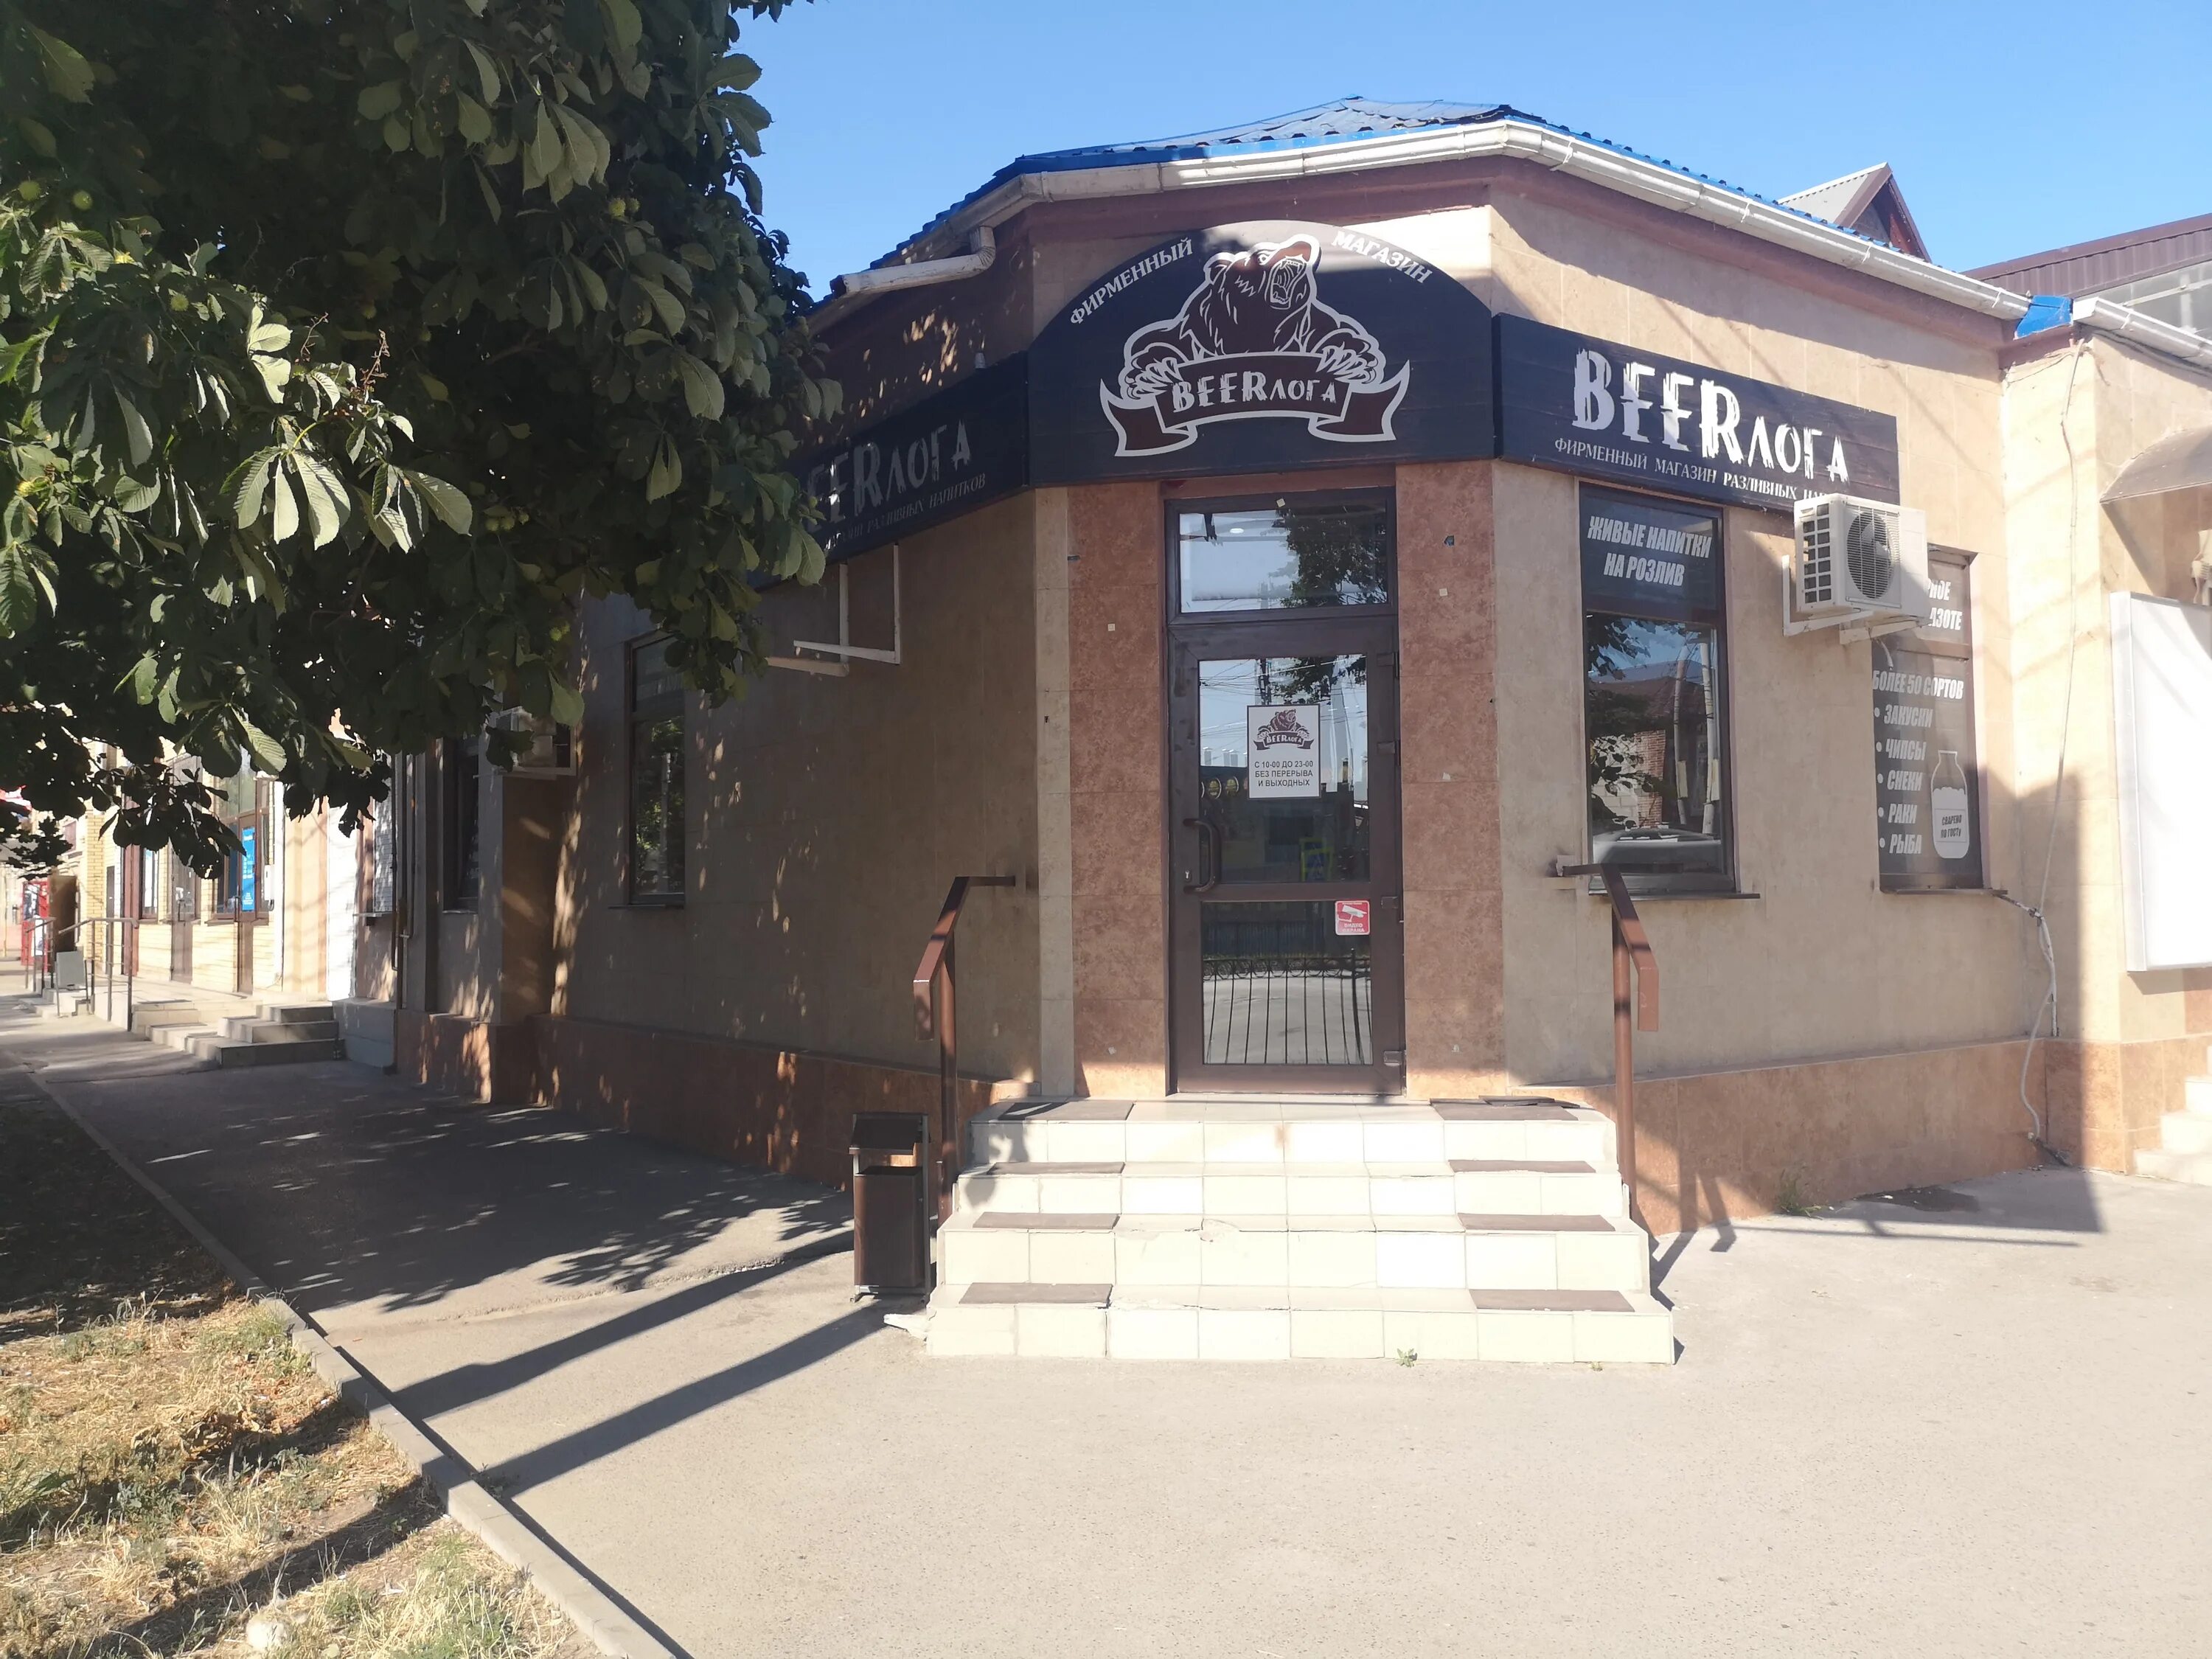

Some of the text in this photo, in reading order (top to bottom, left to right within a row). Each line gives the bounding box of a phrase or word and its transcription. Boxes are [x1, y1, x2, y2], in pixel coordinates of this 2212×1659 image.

[1070, 229, 1433, 325] ФИРМЕННЫЙ МАГАЗИН
[1555, 438, 1647, 470] ФИРМЕННЫЙ
[1655, 458, 1717, 484] МАГАЗИН
[1723, 473, 1797, 500] РАЗЛИВНЫХ
[1587, 516, 1712, 558] ЖИВЫЕ НАПИТКИ
[1604, 553, 1685, 586] НА РОЗЛИВ
[1873, 670, 1964, 699] БОЛЕЕ 50 СОРТОВ
[1884, 704, 1933, 728] ЗАКУСКИ
[1885, 739, 1927, 760] ЧИПСЫ
[1887, 770, 1923, 790] СНЕКИ
[1888, 804, 1917, 824] РАКИ
[1889, 834, 1921, 854] РЫБА
